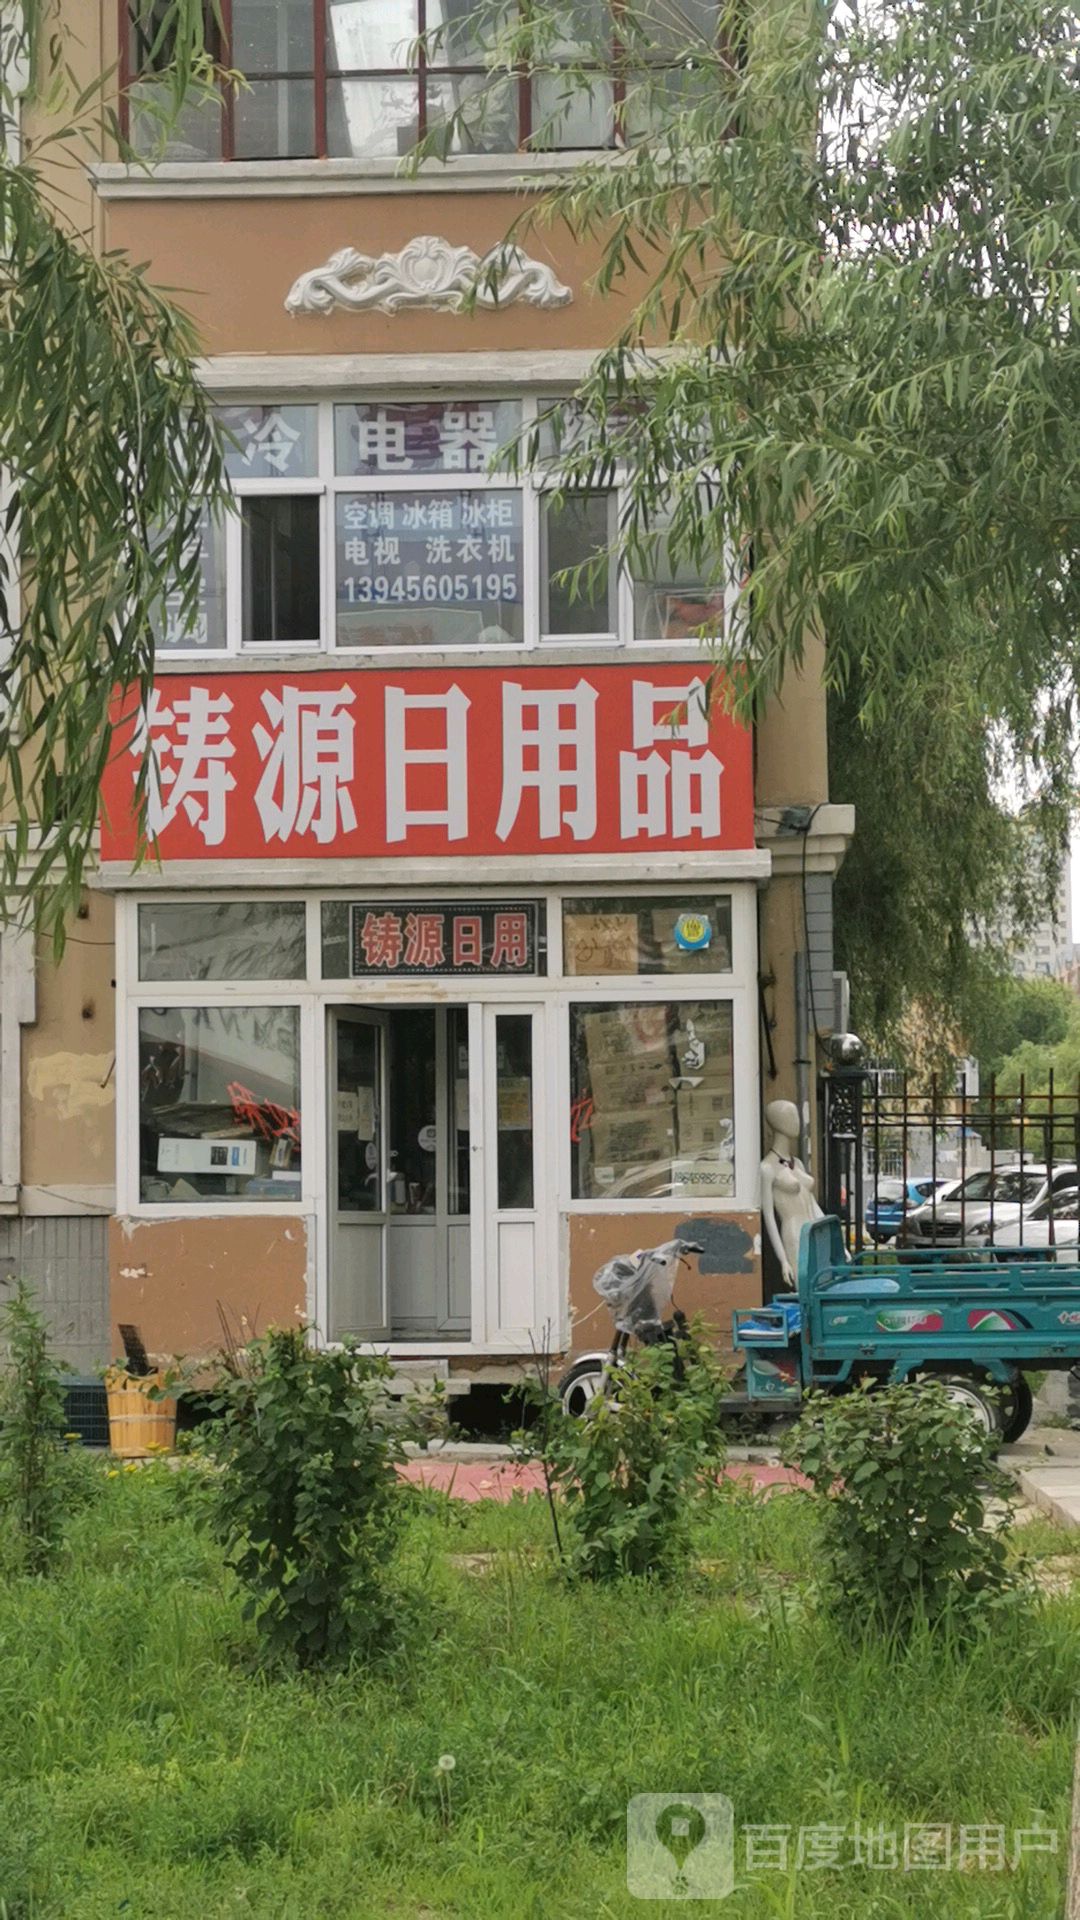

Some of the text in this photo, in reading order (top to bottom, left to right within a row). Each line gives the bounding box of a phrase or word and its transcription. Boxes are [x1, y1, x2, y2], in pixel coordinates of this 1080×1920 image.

[344, 499, 513, 529] 空调 冰箱 冰柜
[345, 535, 515, 565] 电视 洗衣机
[344, 574, 517, 603] 13945605195
[131, 677, 726, 847] 铸源日用品
[361, 911, 529, 968] 铸源日用
